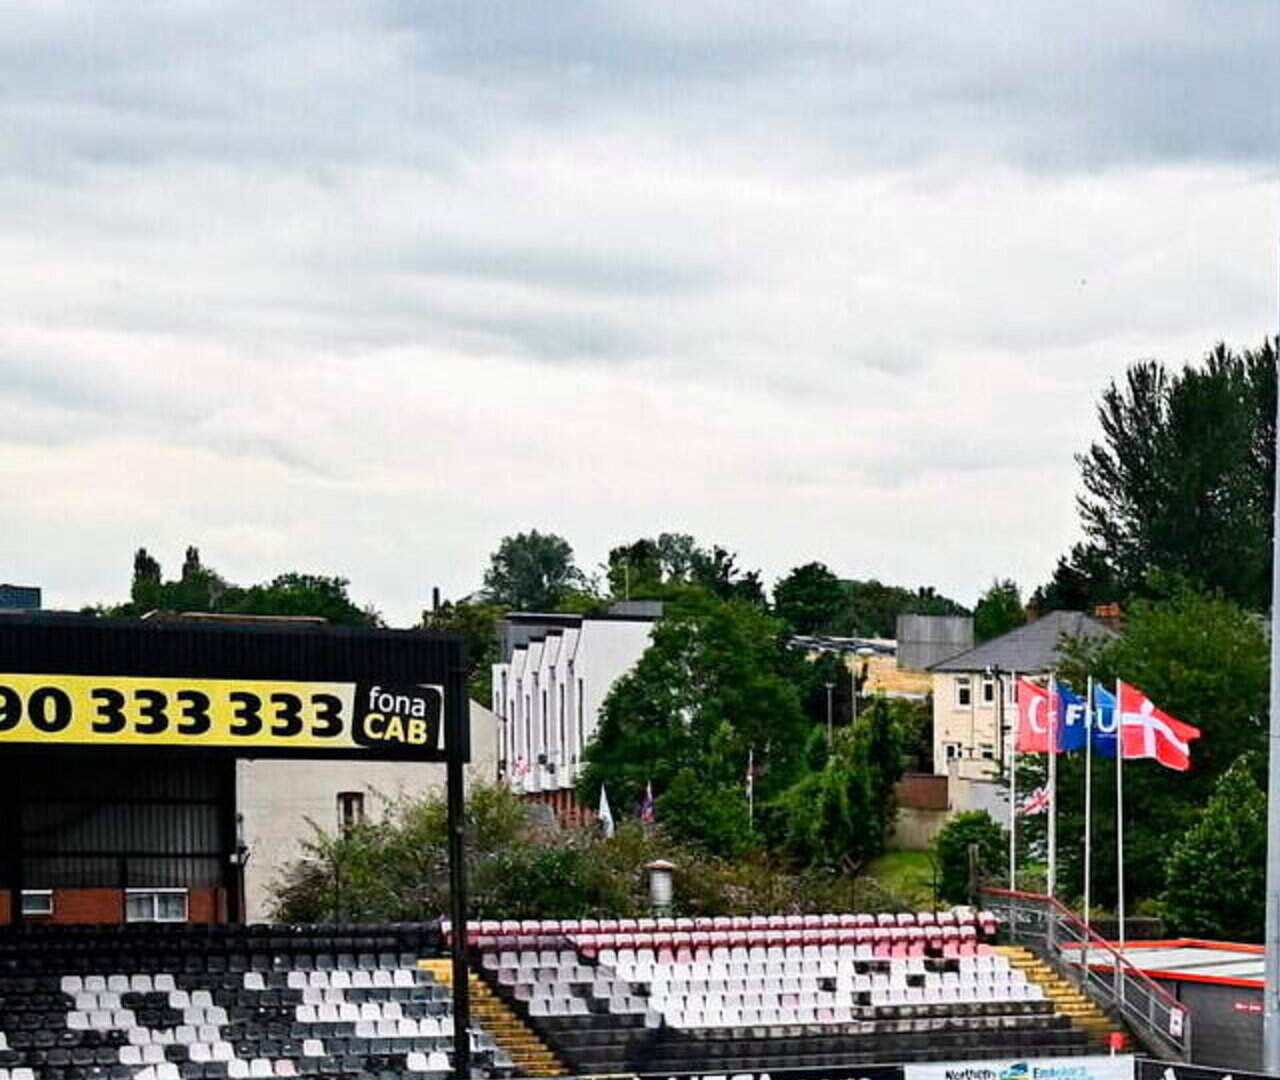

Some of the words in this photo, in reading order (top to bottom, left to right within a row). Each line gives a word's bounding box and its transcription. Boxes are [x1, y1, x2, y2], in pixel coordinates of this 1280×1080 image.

[91, 688, 211, 735] 333
[229, 692, 344, 737] 333
[369, 685, 425, 717] fona
[363, 713, 428, 744] CAB
